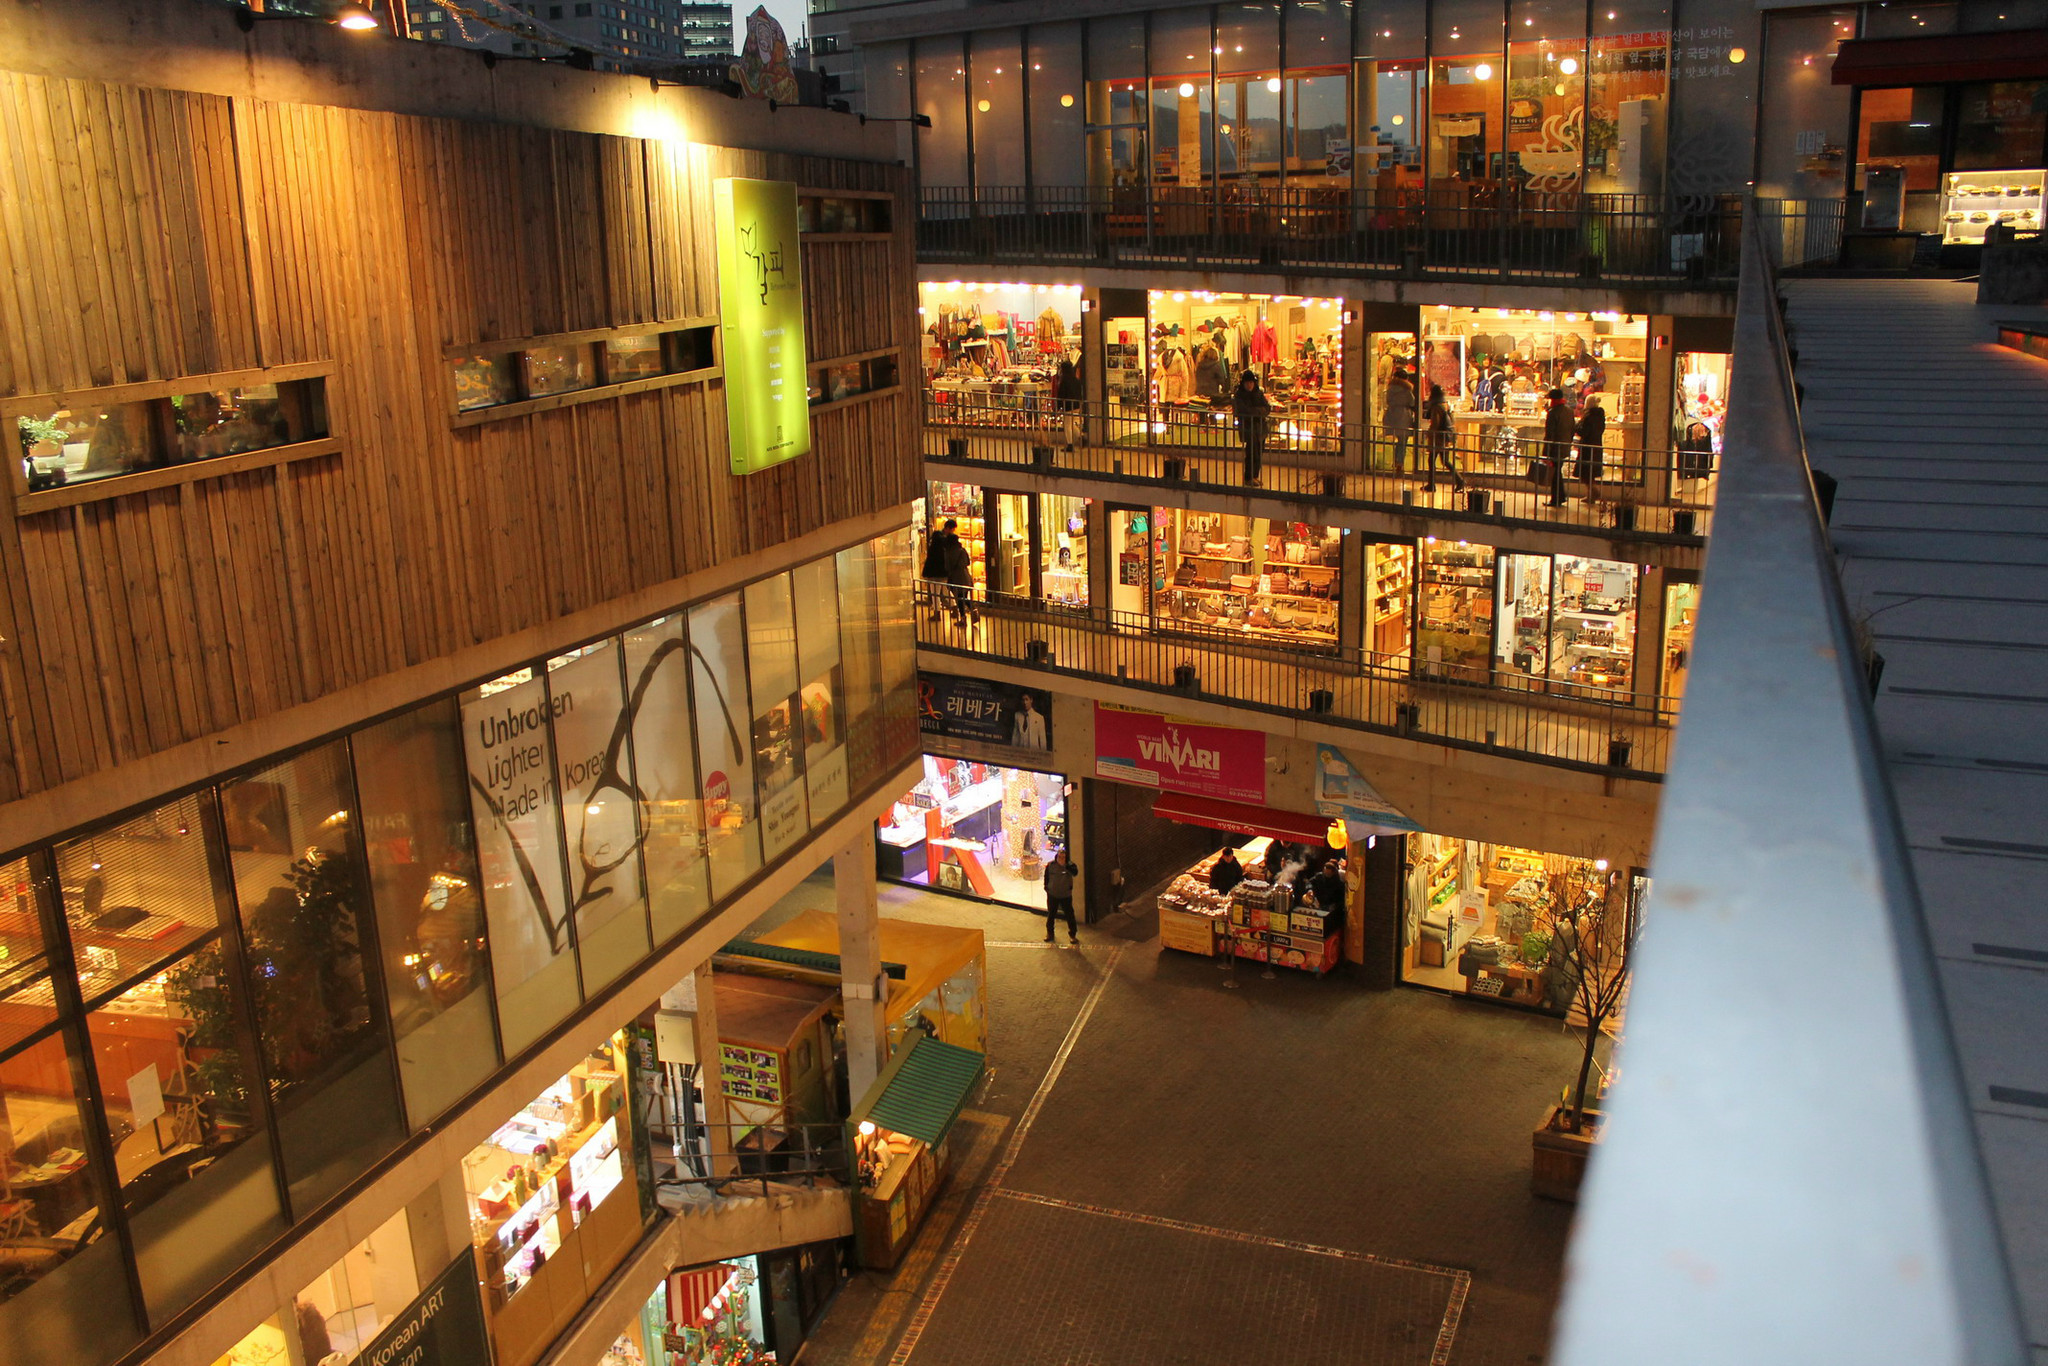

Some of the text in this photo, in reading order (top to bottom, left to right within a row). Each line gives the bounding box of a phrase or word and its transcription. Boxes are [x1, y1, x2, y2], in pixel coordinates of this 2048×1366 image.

[1699, 26, 1734, 39] 보이는
[947, 697, 1002, 721] 레베카
[1137, 733, 1220, 774] VINARI
[372, 1286, 444, 1366] Korean ART
